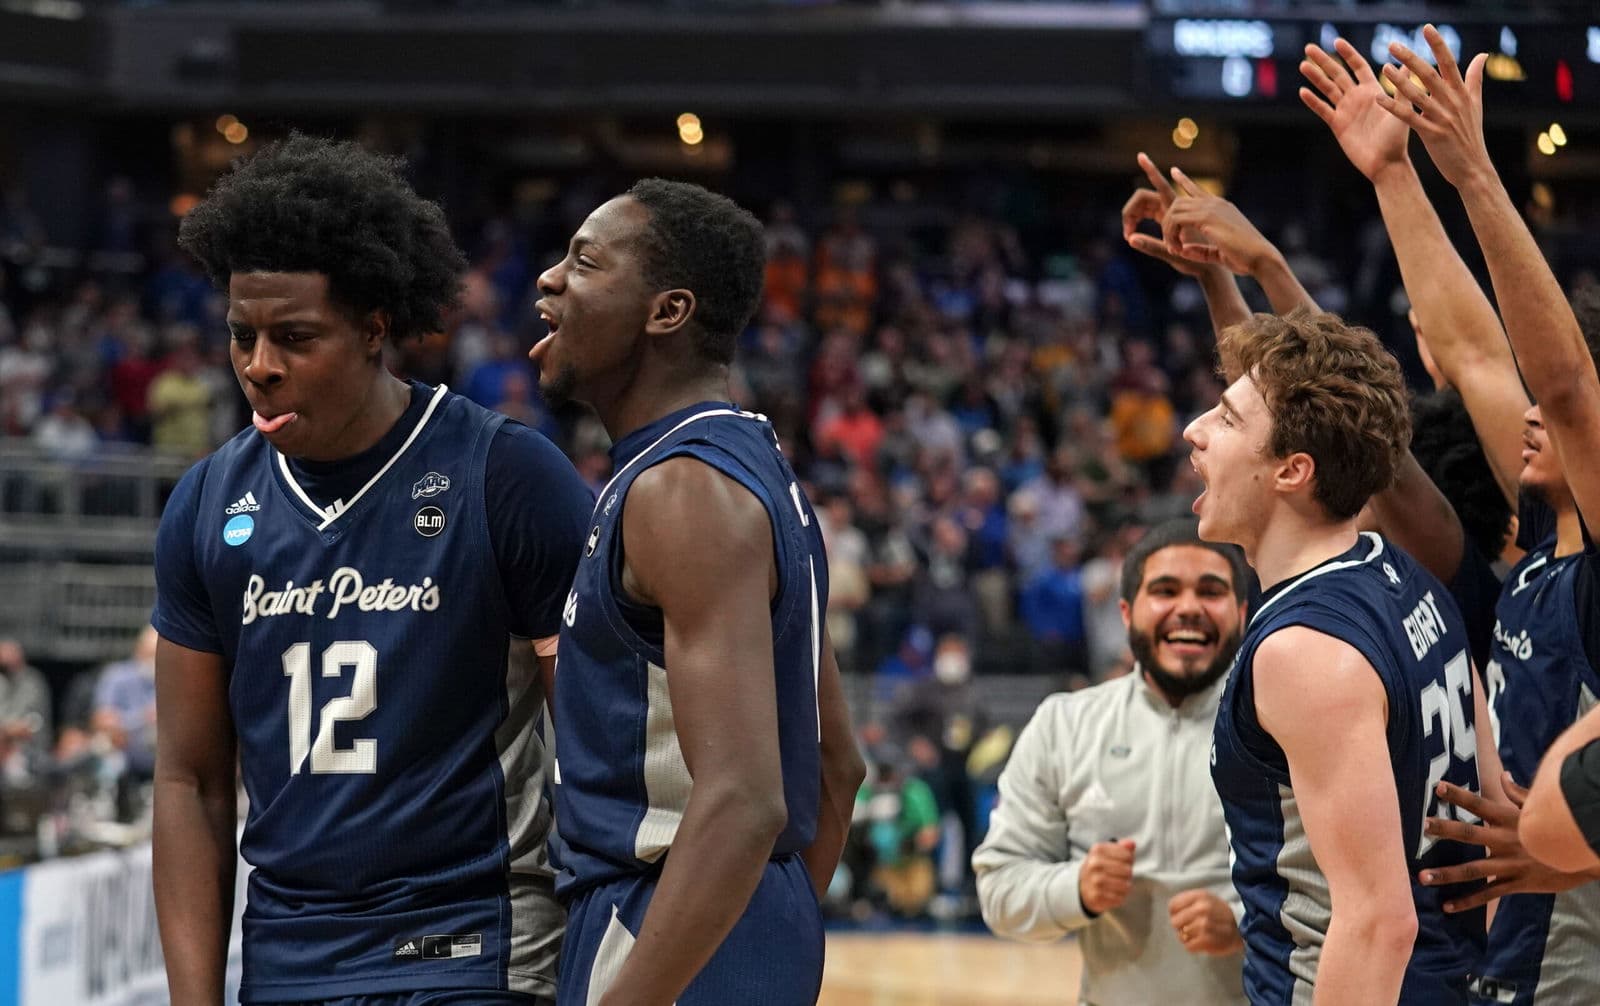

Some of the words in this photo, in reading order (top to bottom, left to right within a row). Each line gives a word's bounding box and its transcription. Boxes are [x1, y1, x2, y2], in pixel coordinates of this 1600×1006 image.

[225, 504, 261, 515] adidas
[417, 515, 442, 528] BLM
[242, 574, 324, 625] Saint
[326, 567, 440, 619] Peter's
[281, 640, 378, 777] 12
[1415, 648, 1484, 860] 25
